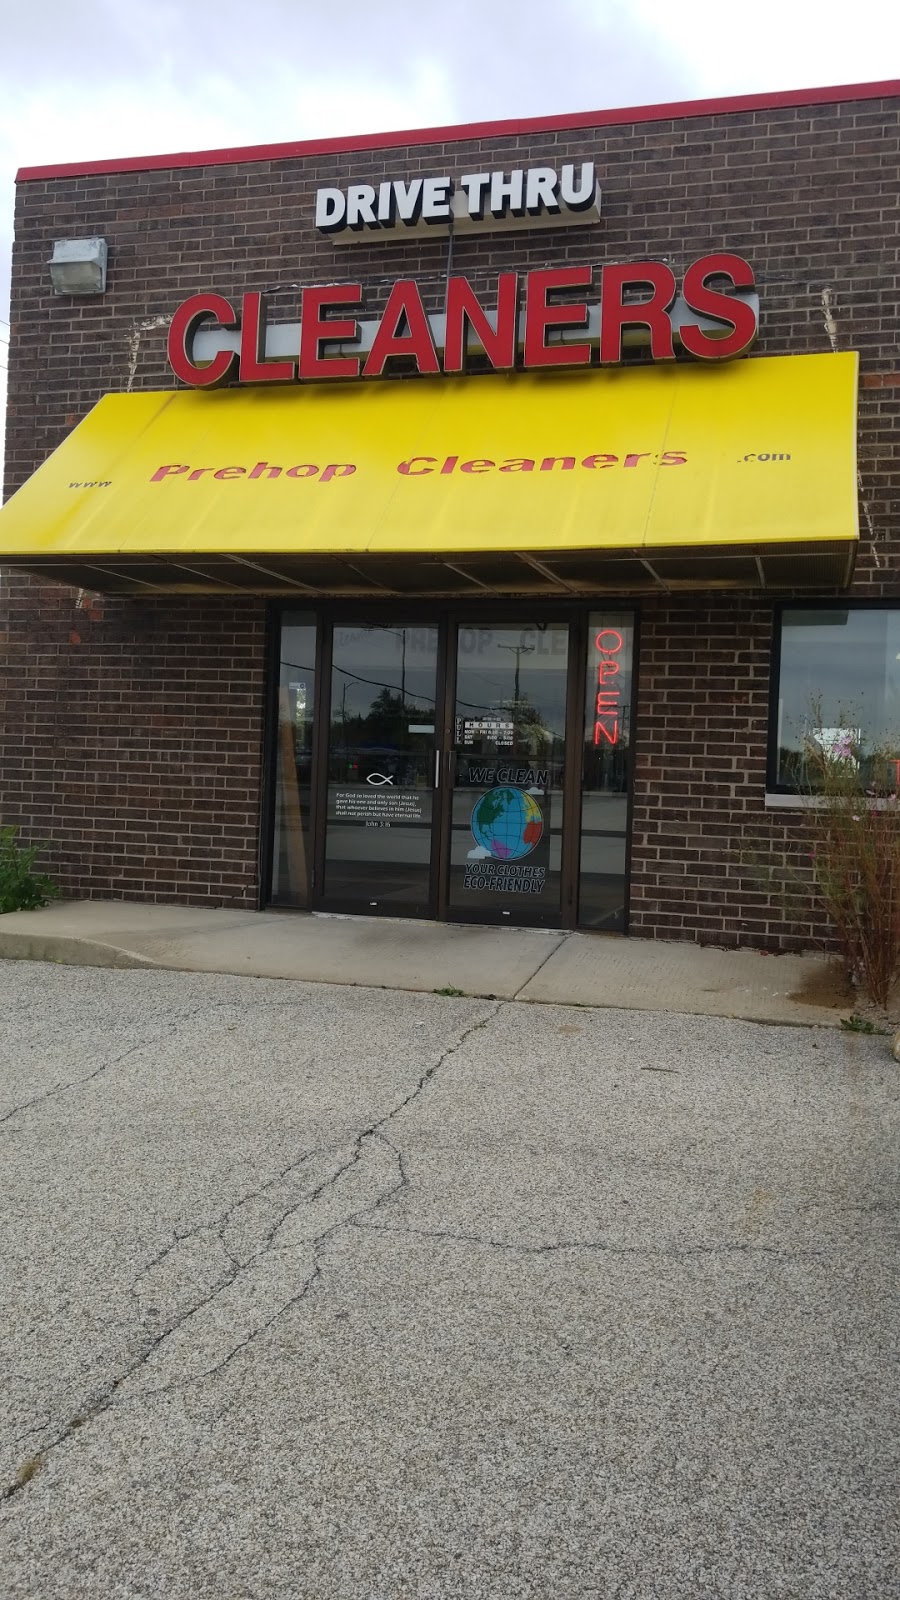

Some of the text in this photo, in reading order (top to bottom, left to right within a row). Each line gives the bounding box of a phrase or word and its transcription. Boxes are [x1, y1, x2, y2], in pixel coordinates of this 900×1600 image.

[315, 162, 597, 230] DRIVE THRU
[168, 253, 758, 389] CLEANERS
[149, 461, 357, 482] Prehop
[396, 451, 689, 476] Cleaners
[593, 629, 622, 746] OPEN
[468, 767, 549, 785] WE CLEAN
[366, 820, 379, 828] John
[465, 863, 546, 879] YOUR CLOTHES
[463, 875, 546, 894] ECO-FRIENDLY
